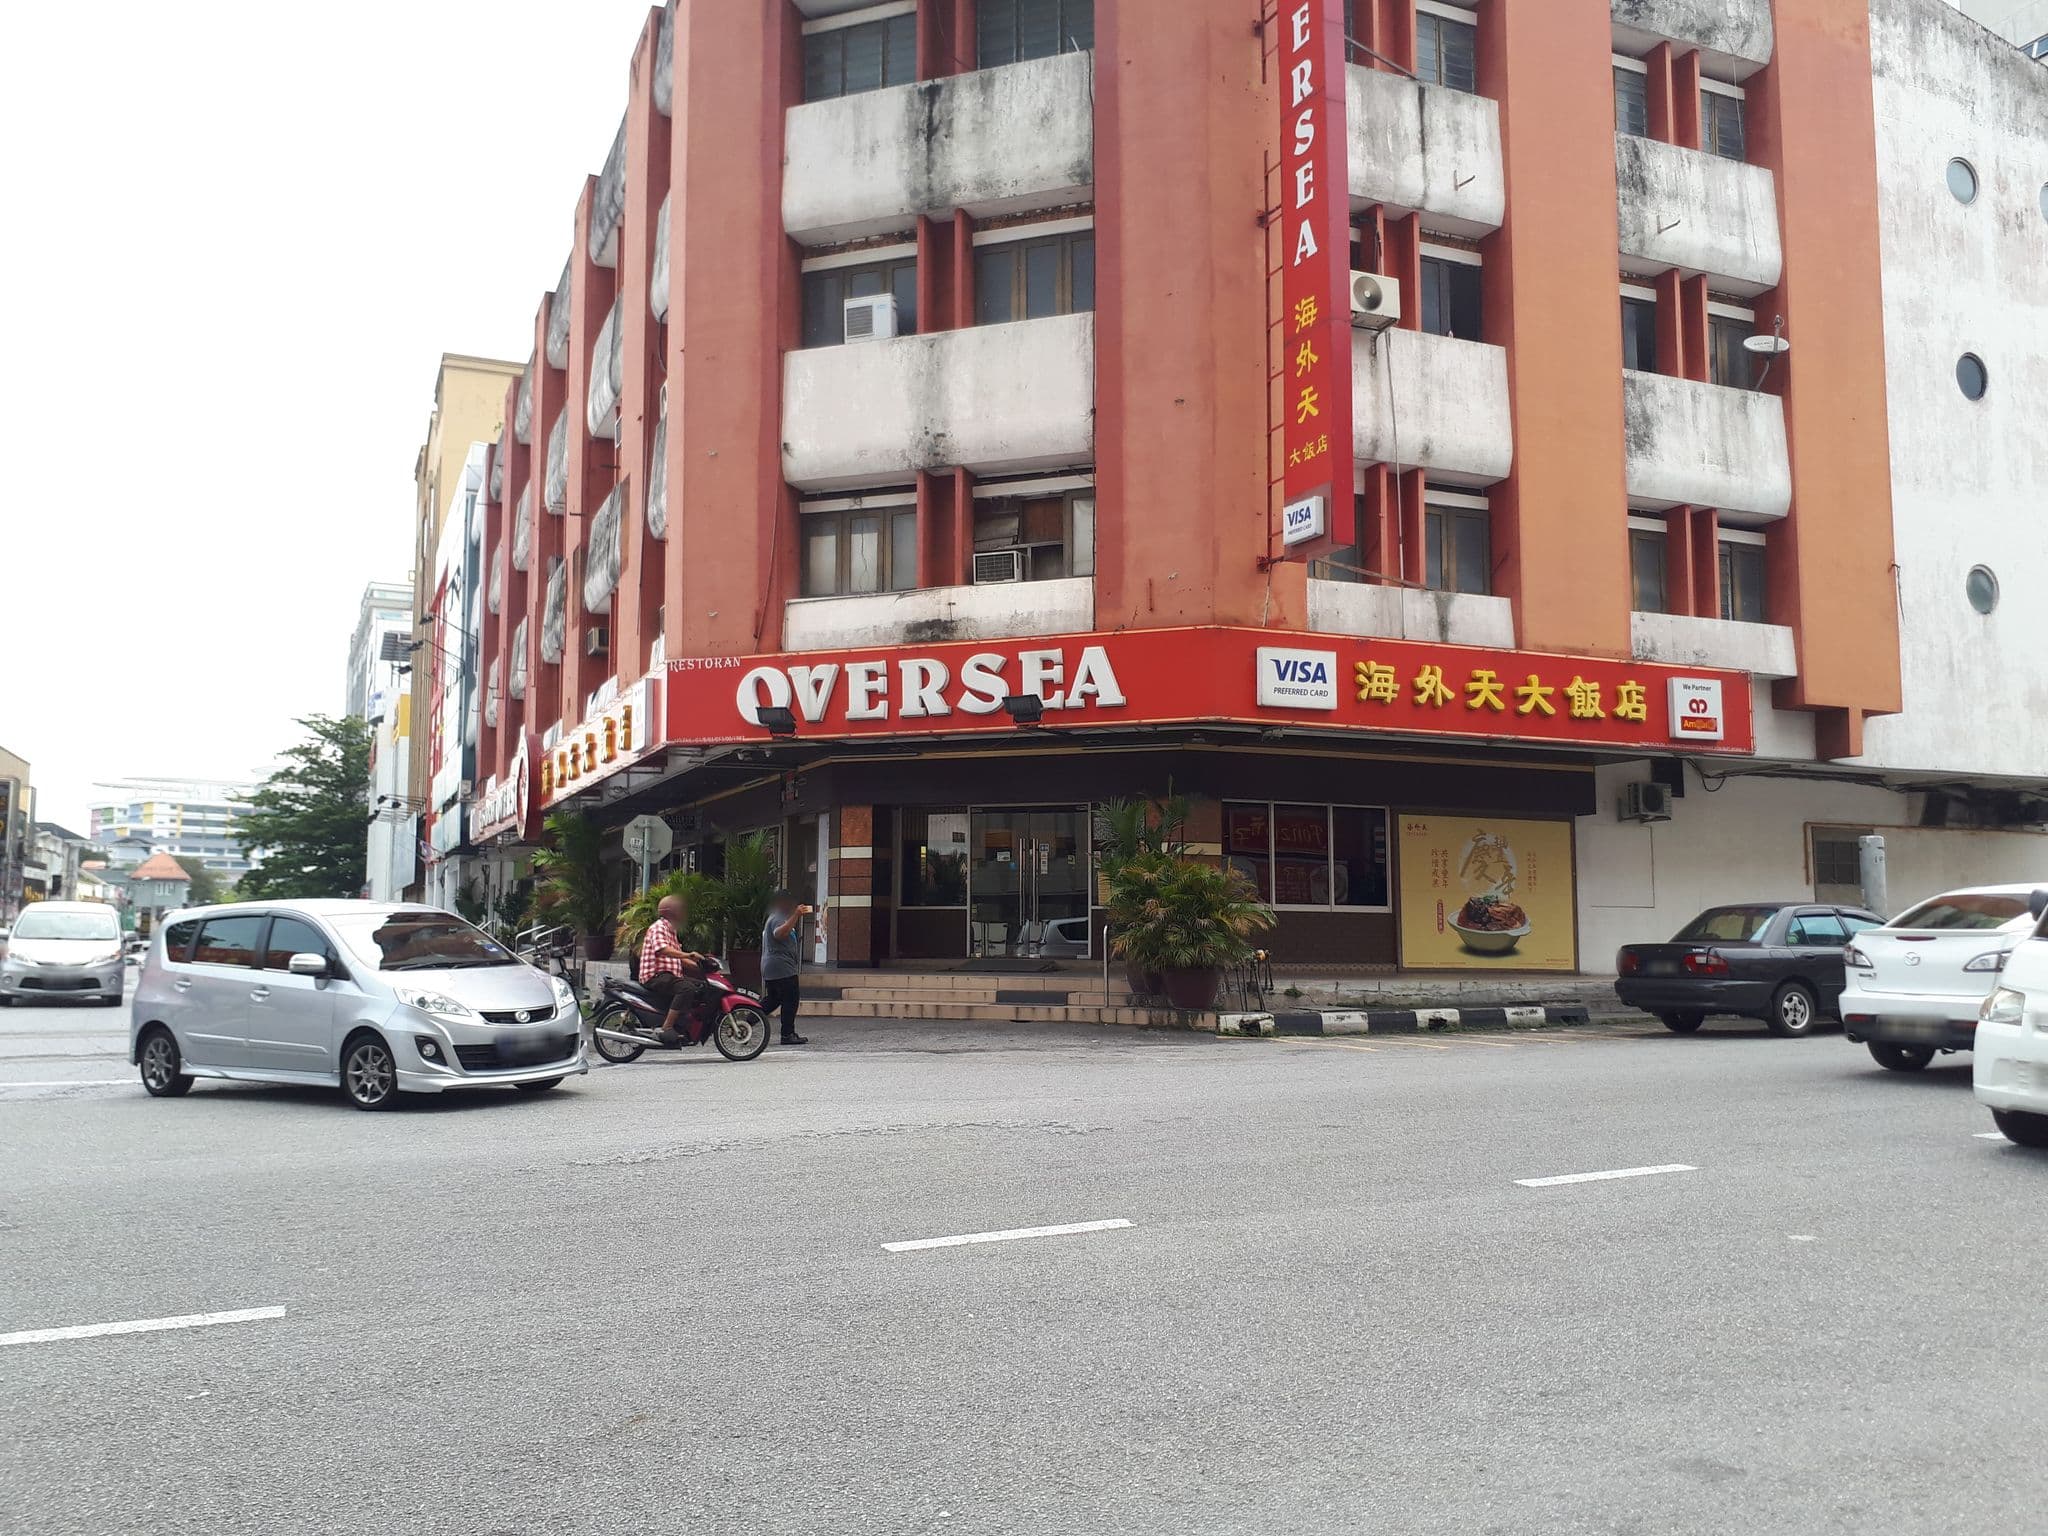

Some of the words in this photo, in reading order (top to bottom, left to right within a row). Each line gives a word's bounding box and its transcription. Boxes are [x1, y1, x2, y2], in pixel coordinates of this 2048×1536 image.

[1294, 295, 1319, 424] 海外天
[1287, 506, 1311, 526] VISA
[670, 656, 741, 673] RESTORAN
[1270, 659, 1328, 684] VISA
[736, 646, 1127, 727] OVERSEA
[1273, 686, 1309, 697] PREFERRED
[1310, 689, 1329, 698] CARD
[1355, 660, 1647, 721] 海外天大飯店
